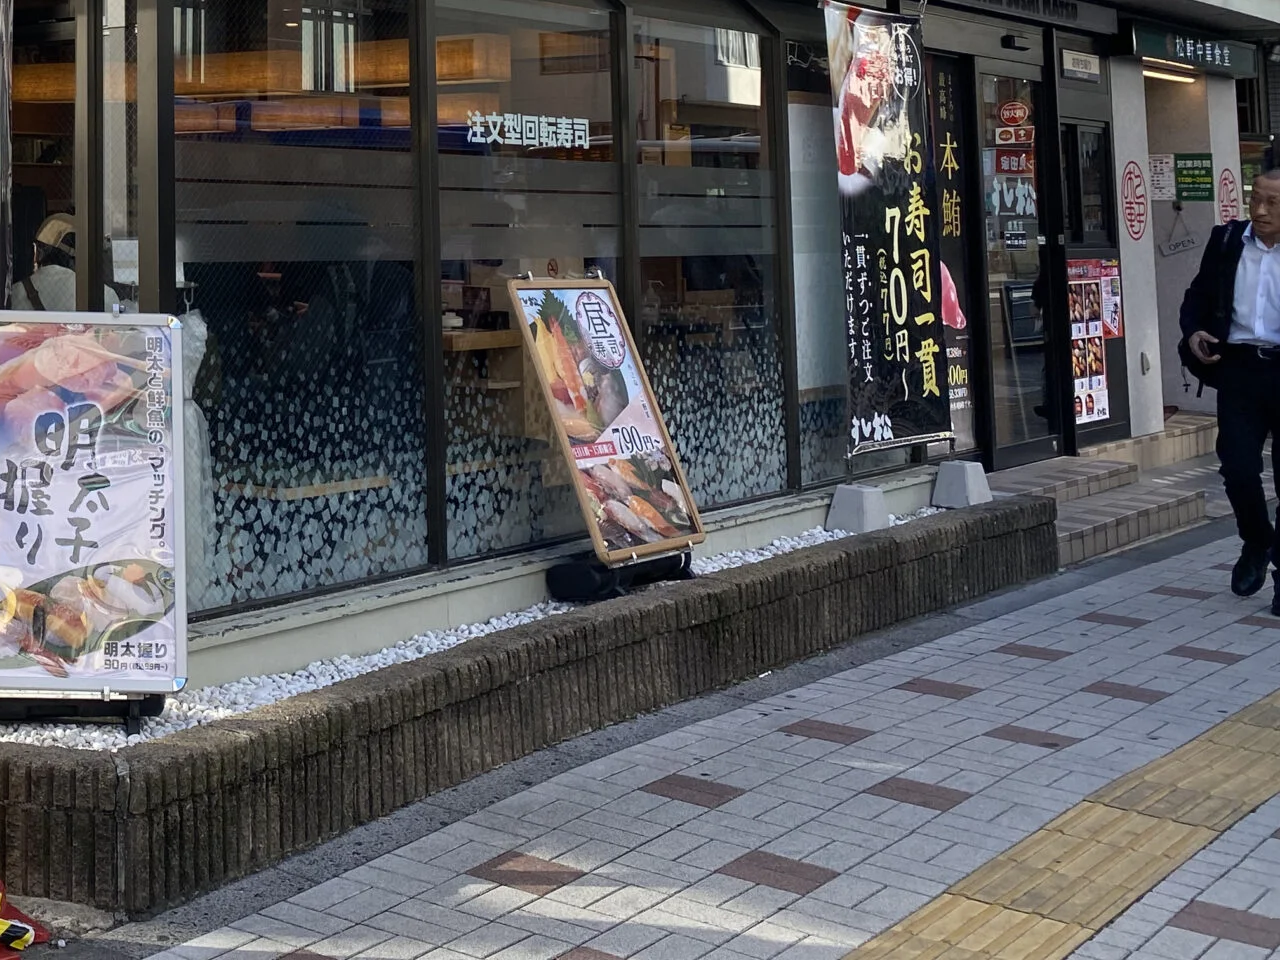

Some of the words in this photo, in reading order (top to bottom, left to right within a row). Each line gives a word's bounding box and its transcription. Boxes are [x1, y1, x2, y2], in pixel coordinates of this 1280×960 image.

[1176, 36, 1231, 66] 松軒中華食堂
[467, 110, 590, 149] 注文型回転寿司
[940, 132, 961, 237] 本鮪
[903, 132, 940, 397] お寿司一貫
[1169, 238, 1196, 252] OPEN
[842, 232, 858, 367] いただけます。
[145, 336, 167, 548] 明太と鮮魚の、マッチング。
[852, 412, 895, 445] すし松
[34, 402, 111, 565] 明太子
[103, 642, 168, 658] 明太握り
